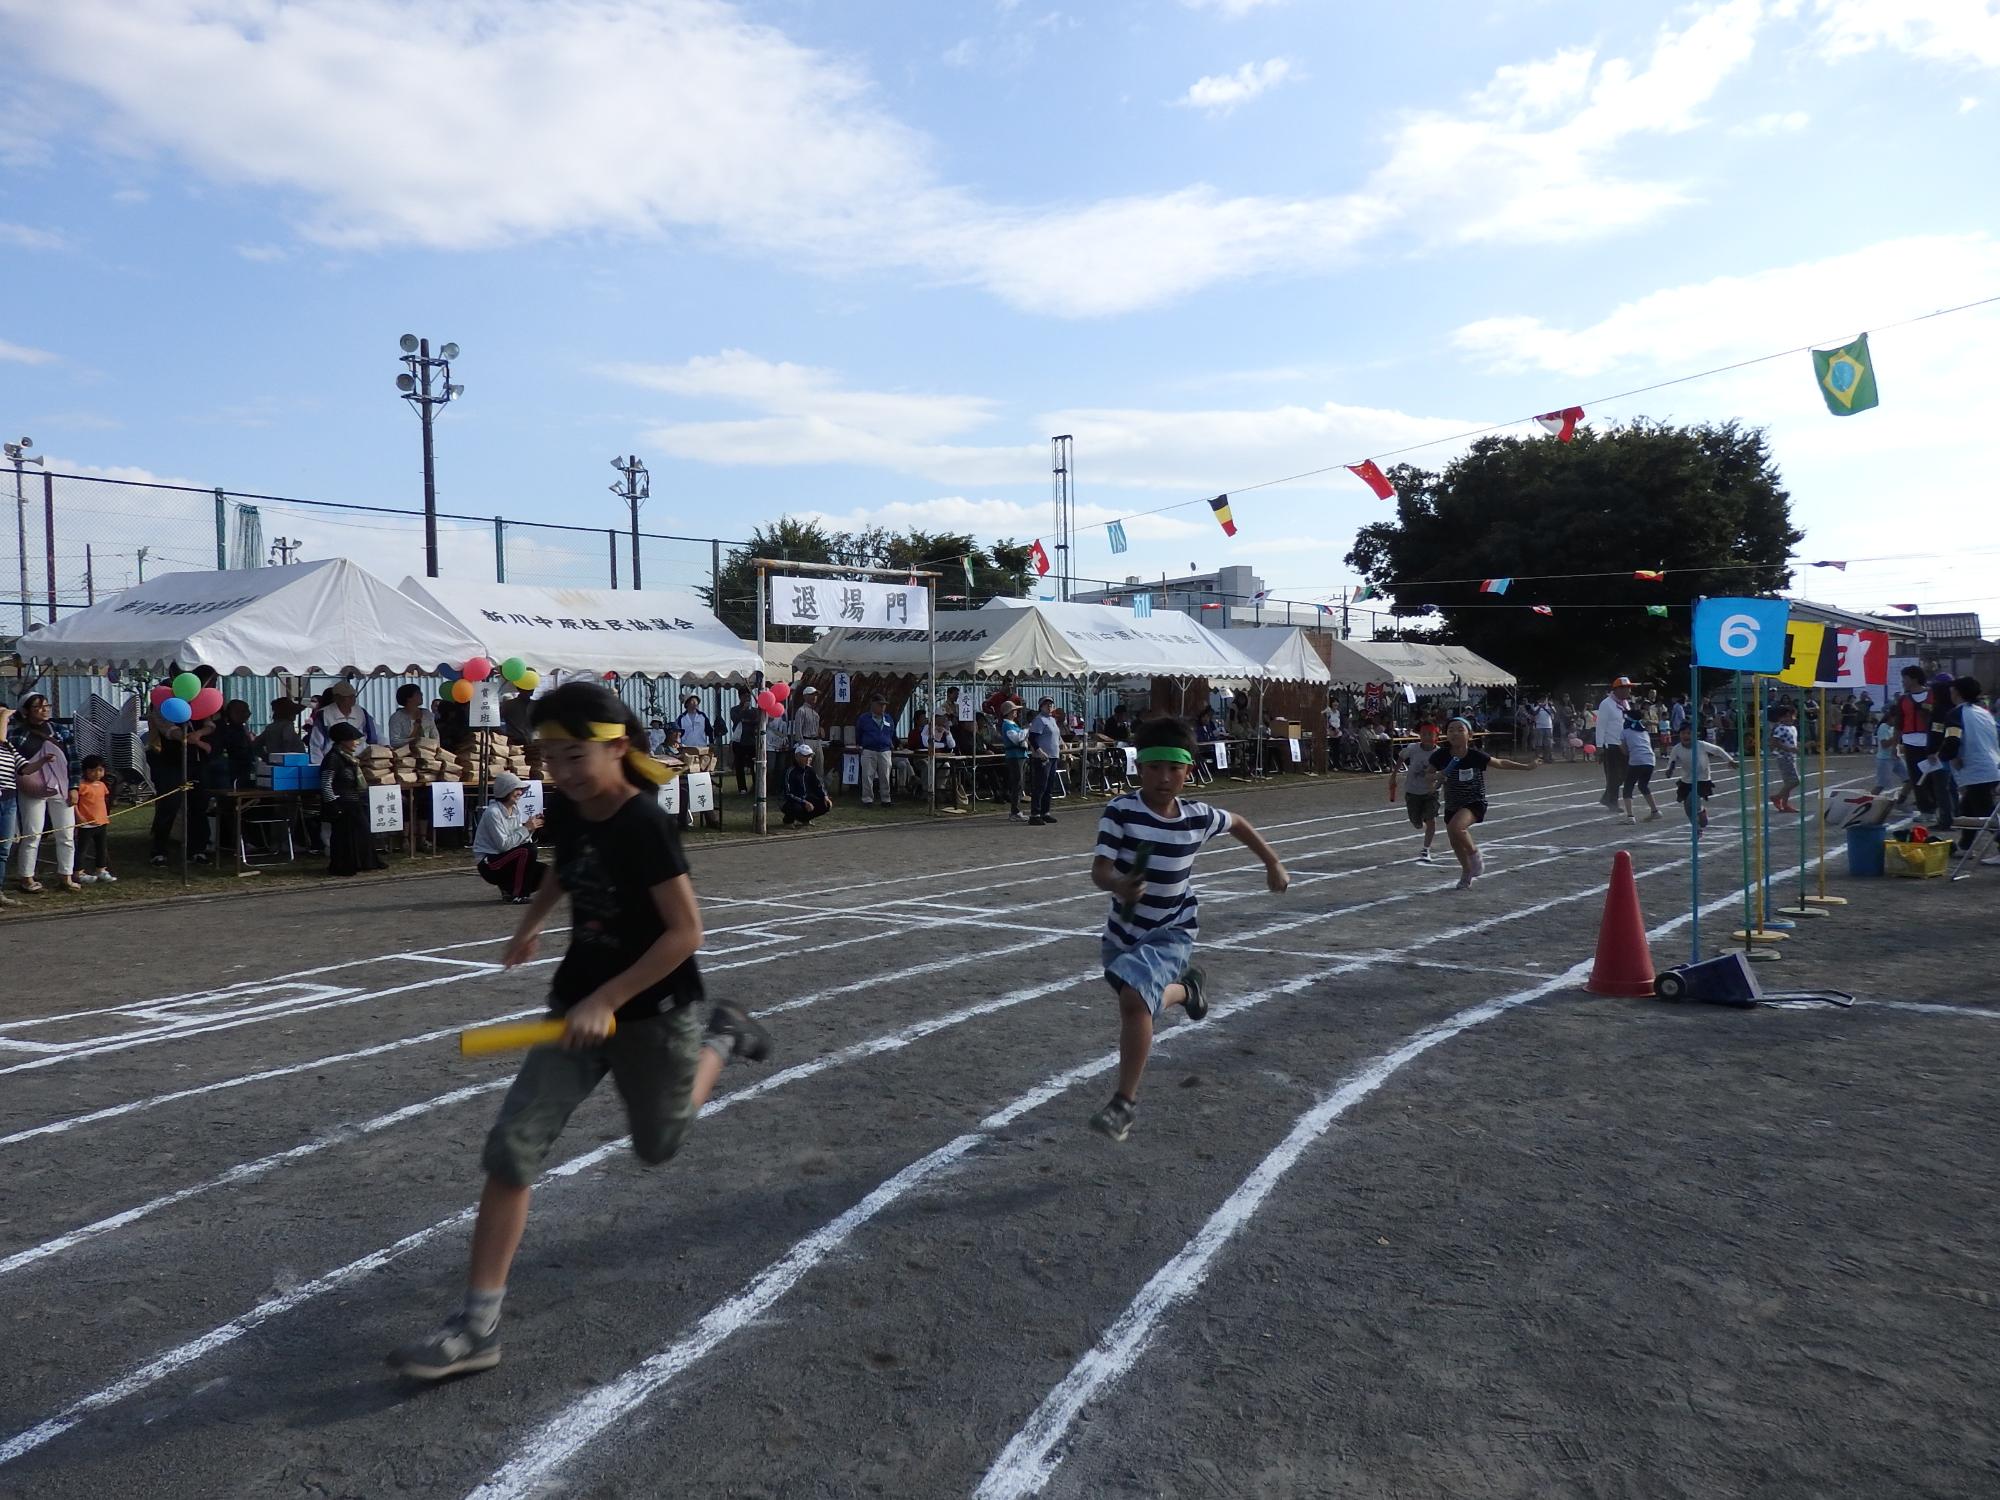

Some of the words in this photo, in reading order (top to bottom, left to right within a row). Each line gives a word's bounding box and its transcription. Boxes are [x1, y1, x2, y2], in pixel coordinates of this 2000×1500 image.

[792, 584, 908, 625] 退場門
[480, 608, 695, 631] 新川中原住民協議会
[1719, 614, 1761, 657] 6
[838, 674, 848, 701] 本部
[962, 695, 971, 719] 受付
[442, 788, 455, 822] 六等
[695, 782, 707, 807] 一等
